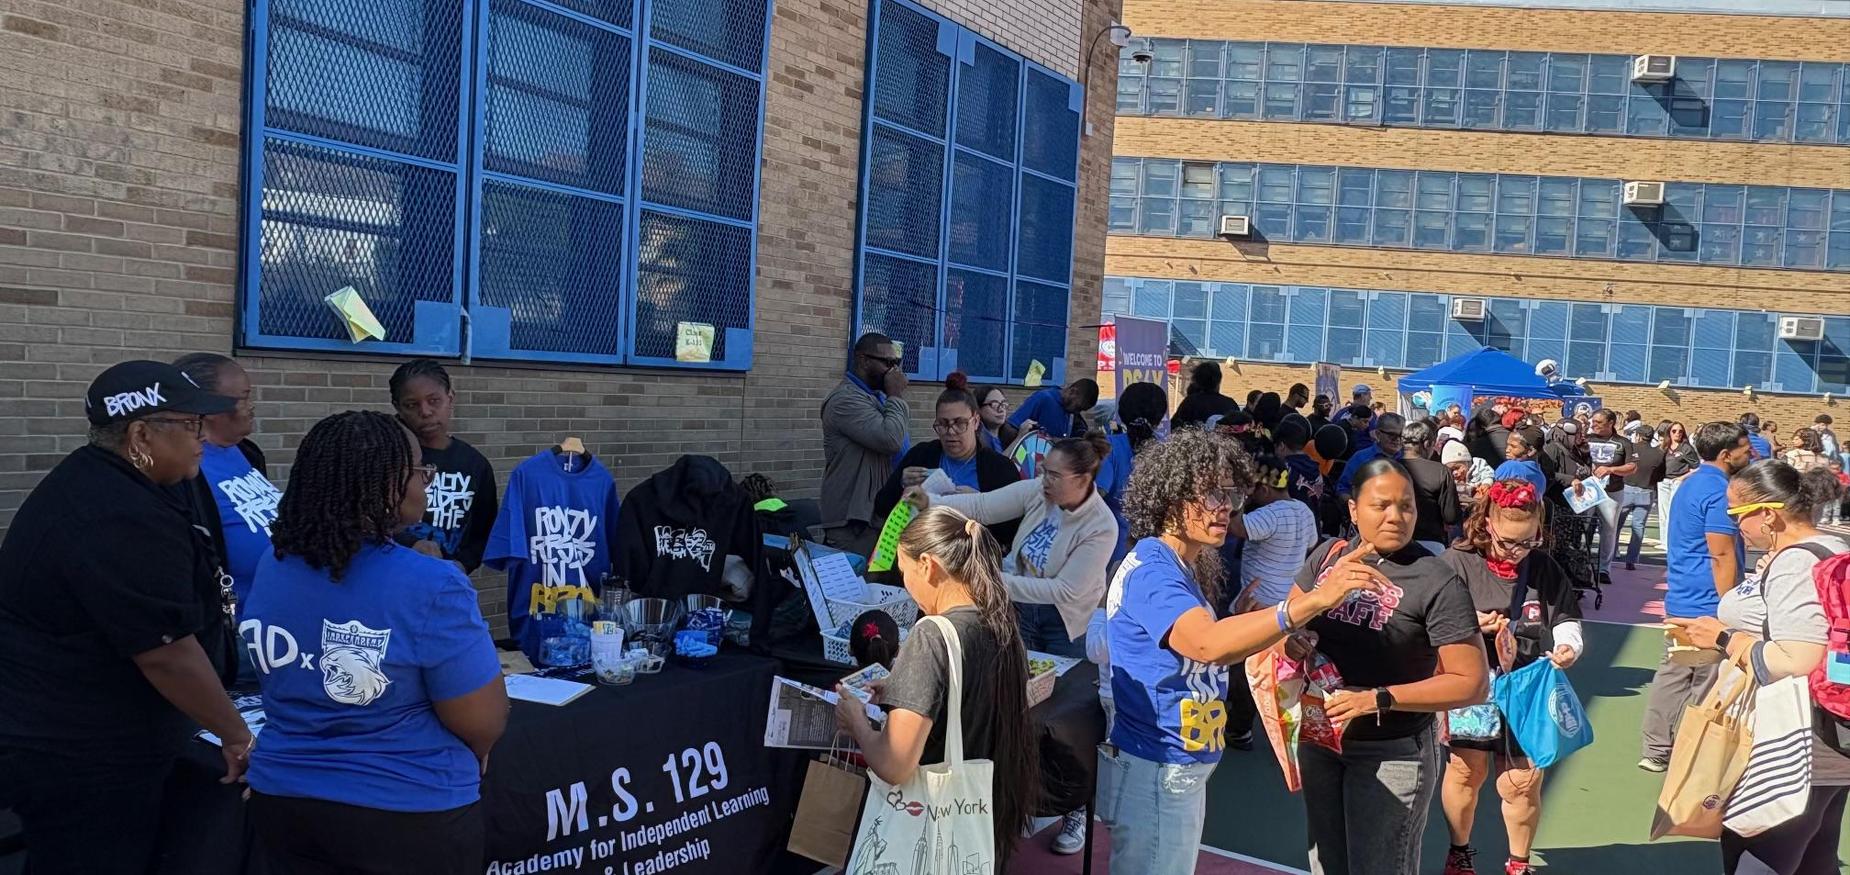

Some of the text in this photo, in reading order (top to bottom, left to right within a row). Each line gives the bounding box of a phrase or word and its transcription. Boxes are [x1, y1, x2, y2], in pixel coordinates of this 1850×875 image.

[1123, 352, 1163, 367] WELCOME TO
[103, 382, 167, 417] BRONX
[431, 471, 472, 493] ALTY
[426, 506, 465, 530] THE
[661, 741, 729, 804] 129
[927, 798, 989, 822] Nw York
[486, 786, 770, 875] Academy for Independent Learning
[622, 837, 712, 875] Leadership
